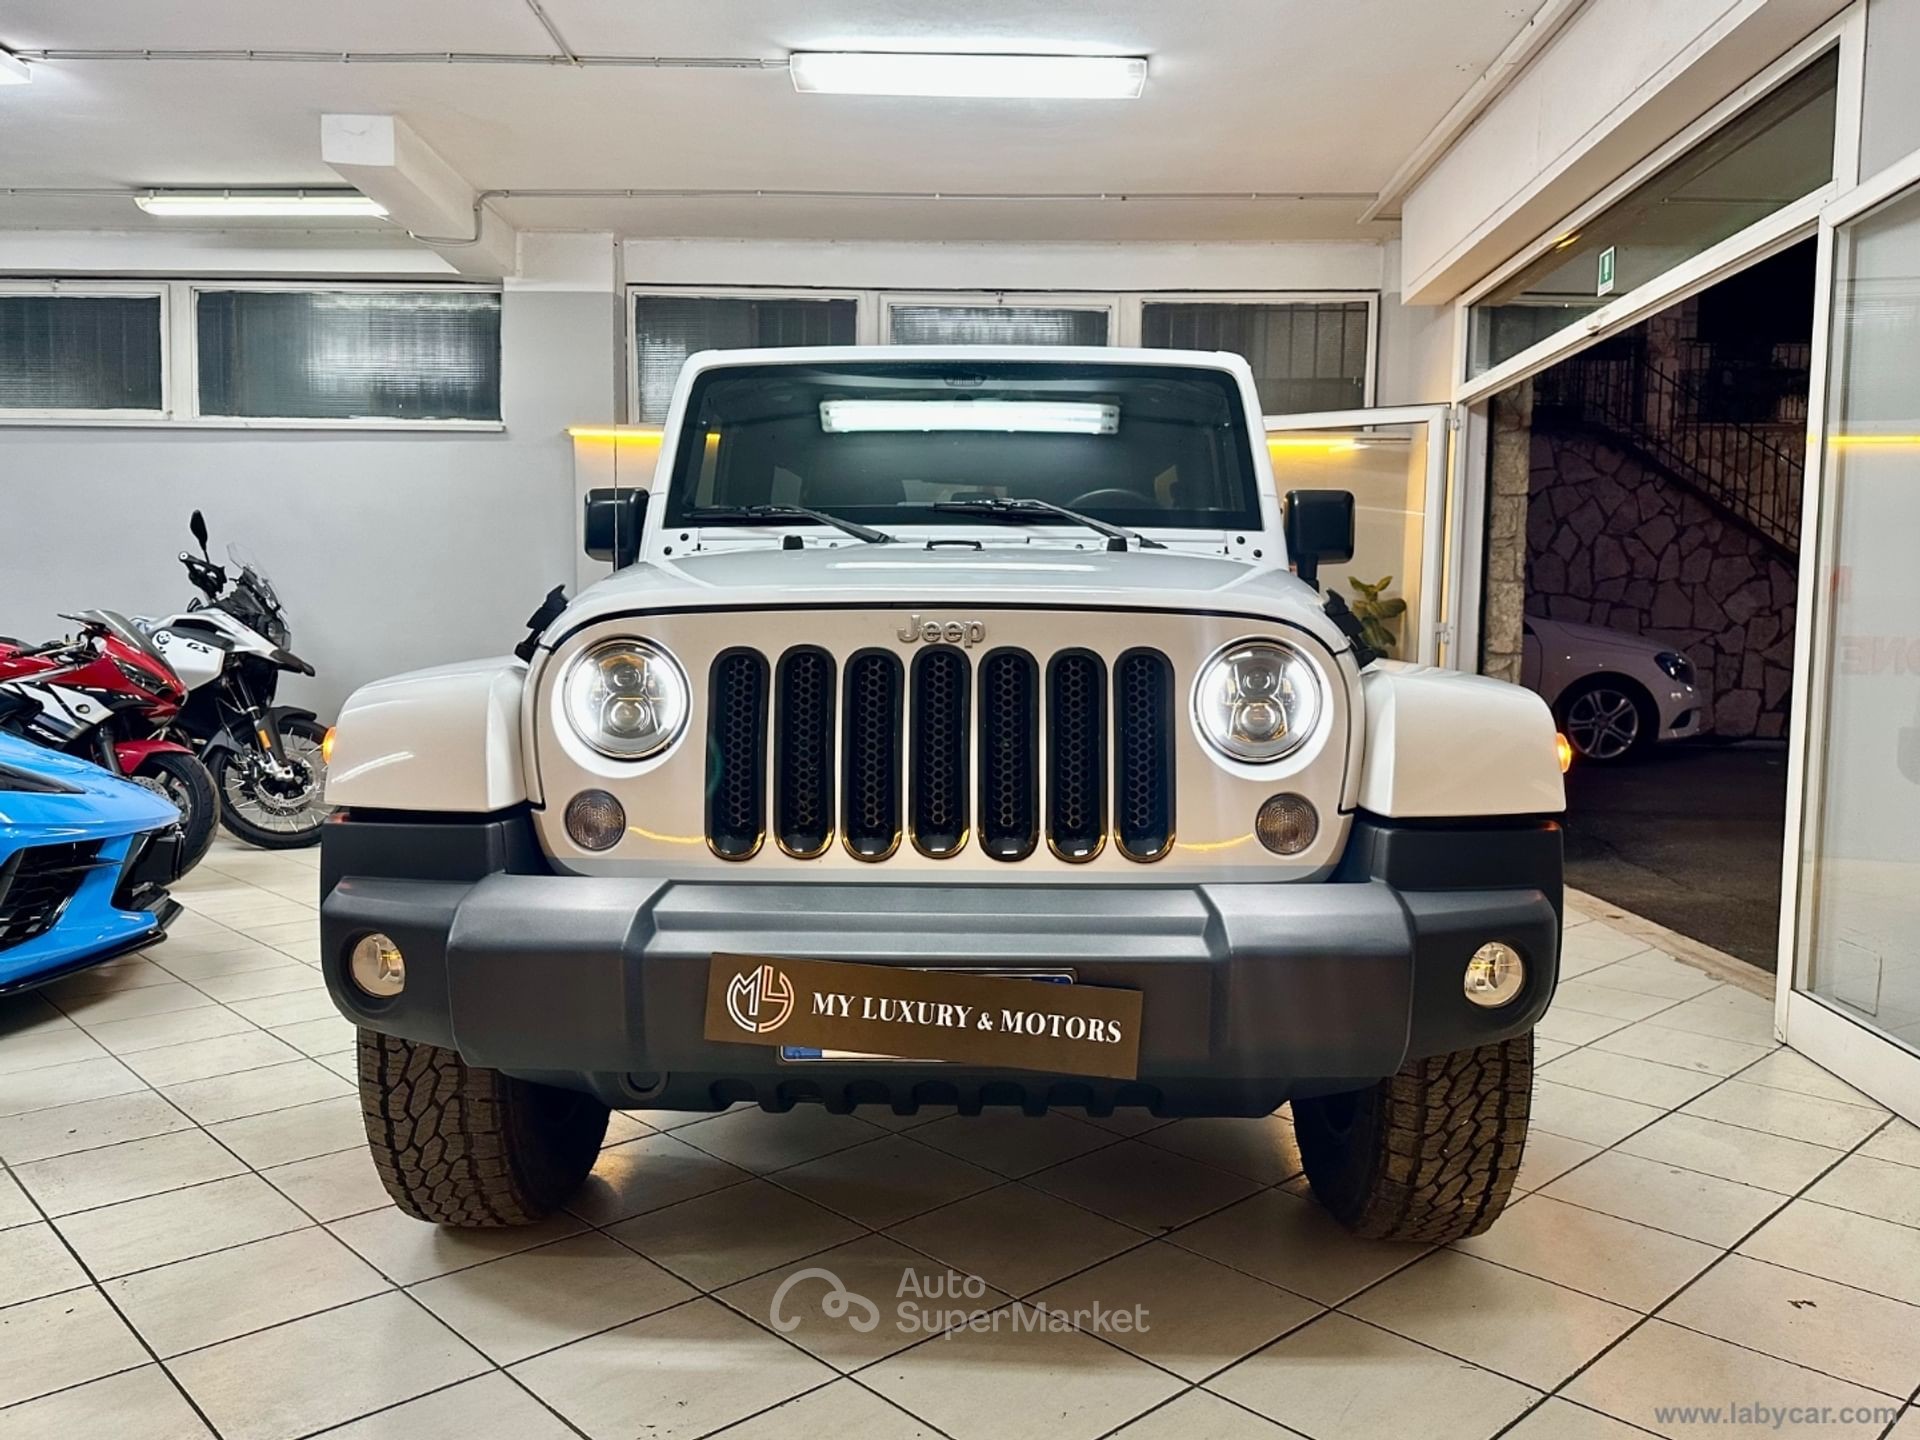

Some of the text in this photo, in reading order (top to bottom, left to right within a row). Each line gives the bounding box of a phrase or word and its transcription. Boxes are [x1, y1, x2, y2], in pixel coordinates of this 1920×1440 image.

[896, 614, 985, 649] Jeep
[811, 991, 1122, 1044] MY LUXURY & MOTORS
